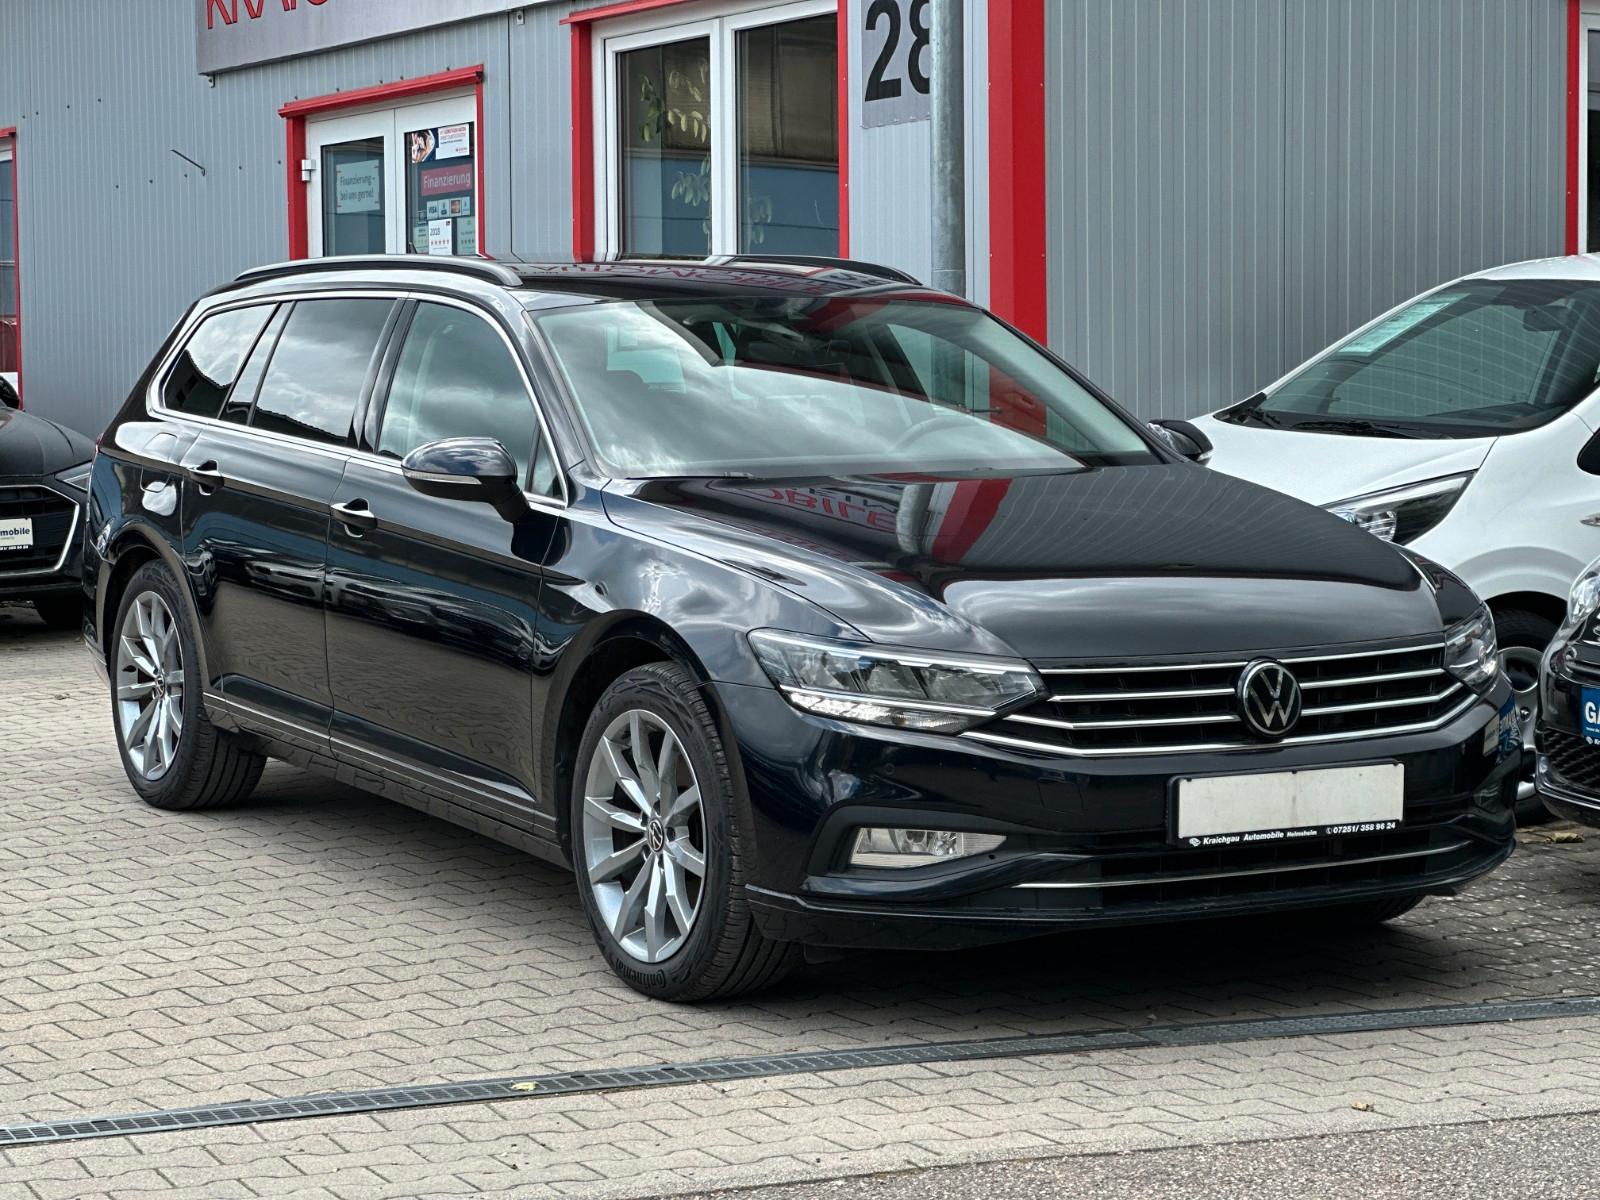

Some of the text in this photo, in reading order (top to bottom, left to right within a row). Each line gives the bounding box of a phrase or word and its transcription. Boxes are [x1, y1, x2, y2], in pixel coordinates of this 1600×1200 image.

[865, 0, 930, 102] 28
[423, 171, 471, 190] Finanzierung
[1203, 834, 1240, 845] Kraichgau
[1243, 830, 1285, 842] Automobile
[1386, 821, 1396, 830] 24
[615, 958, 667, 989] Continental
